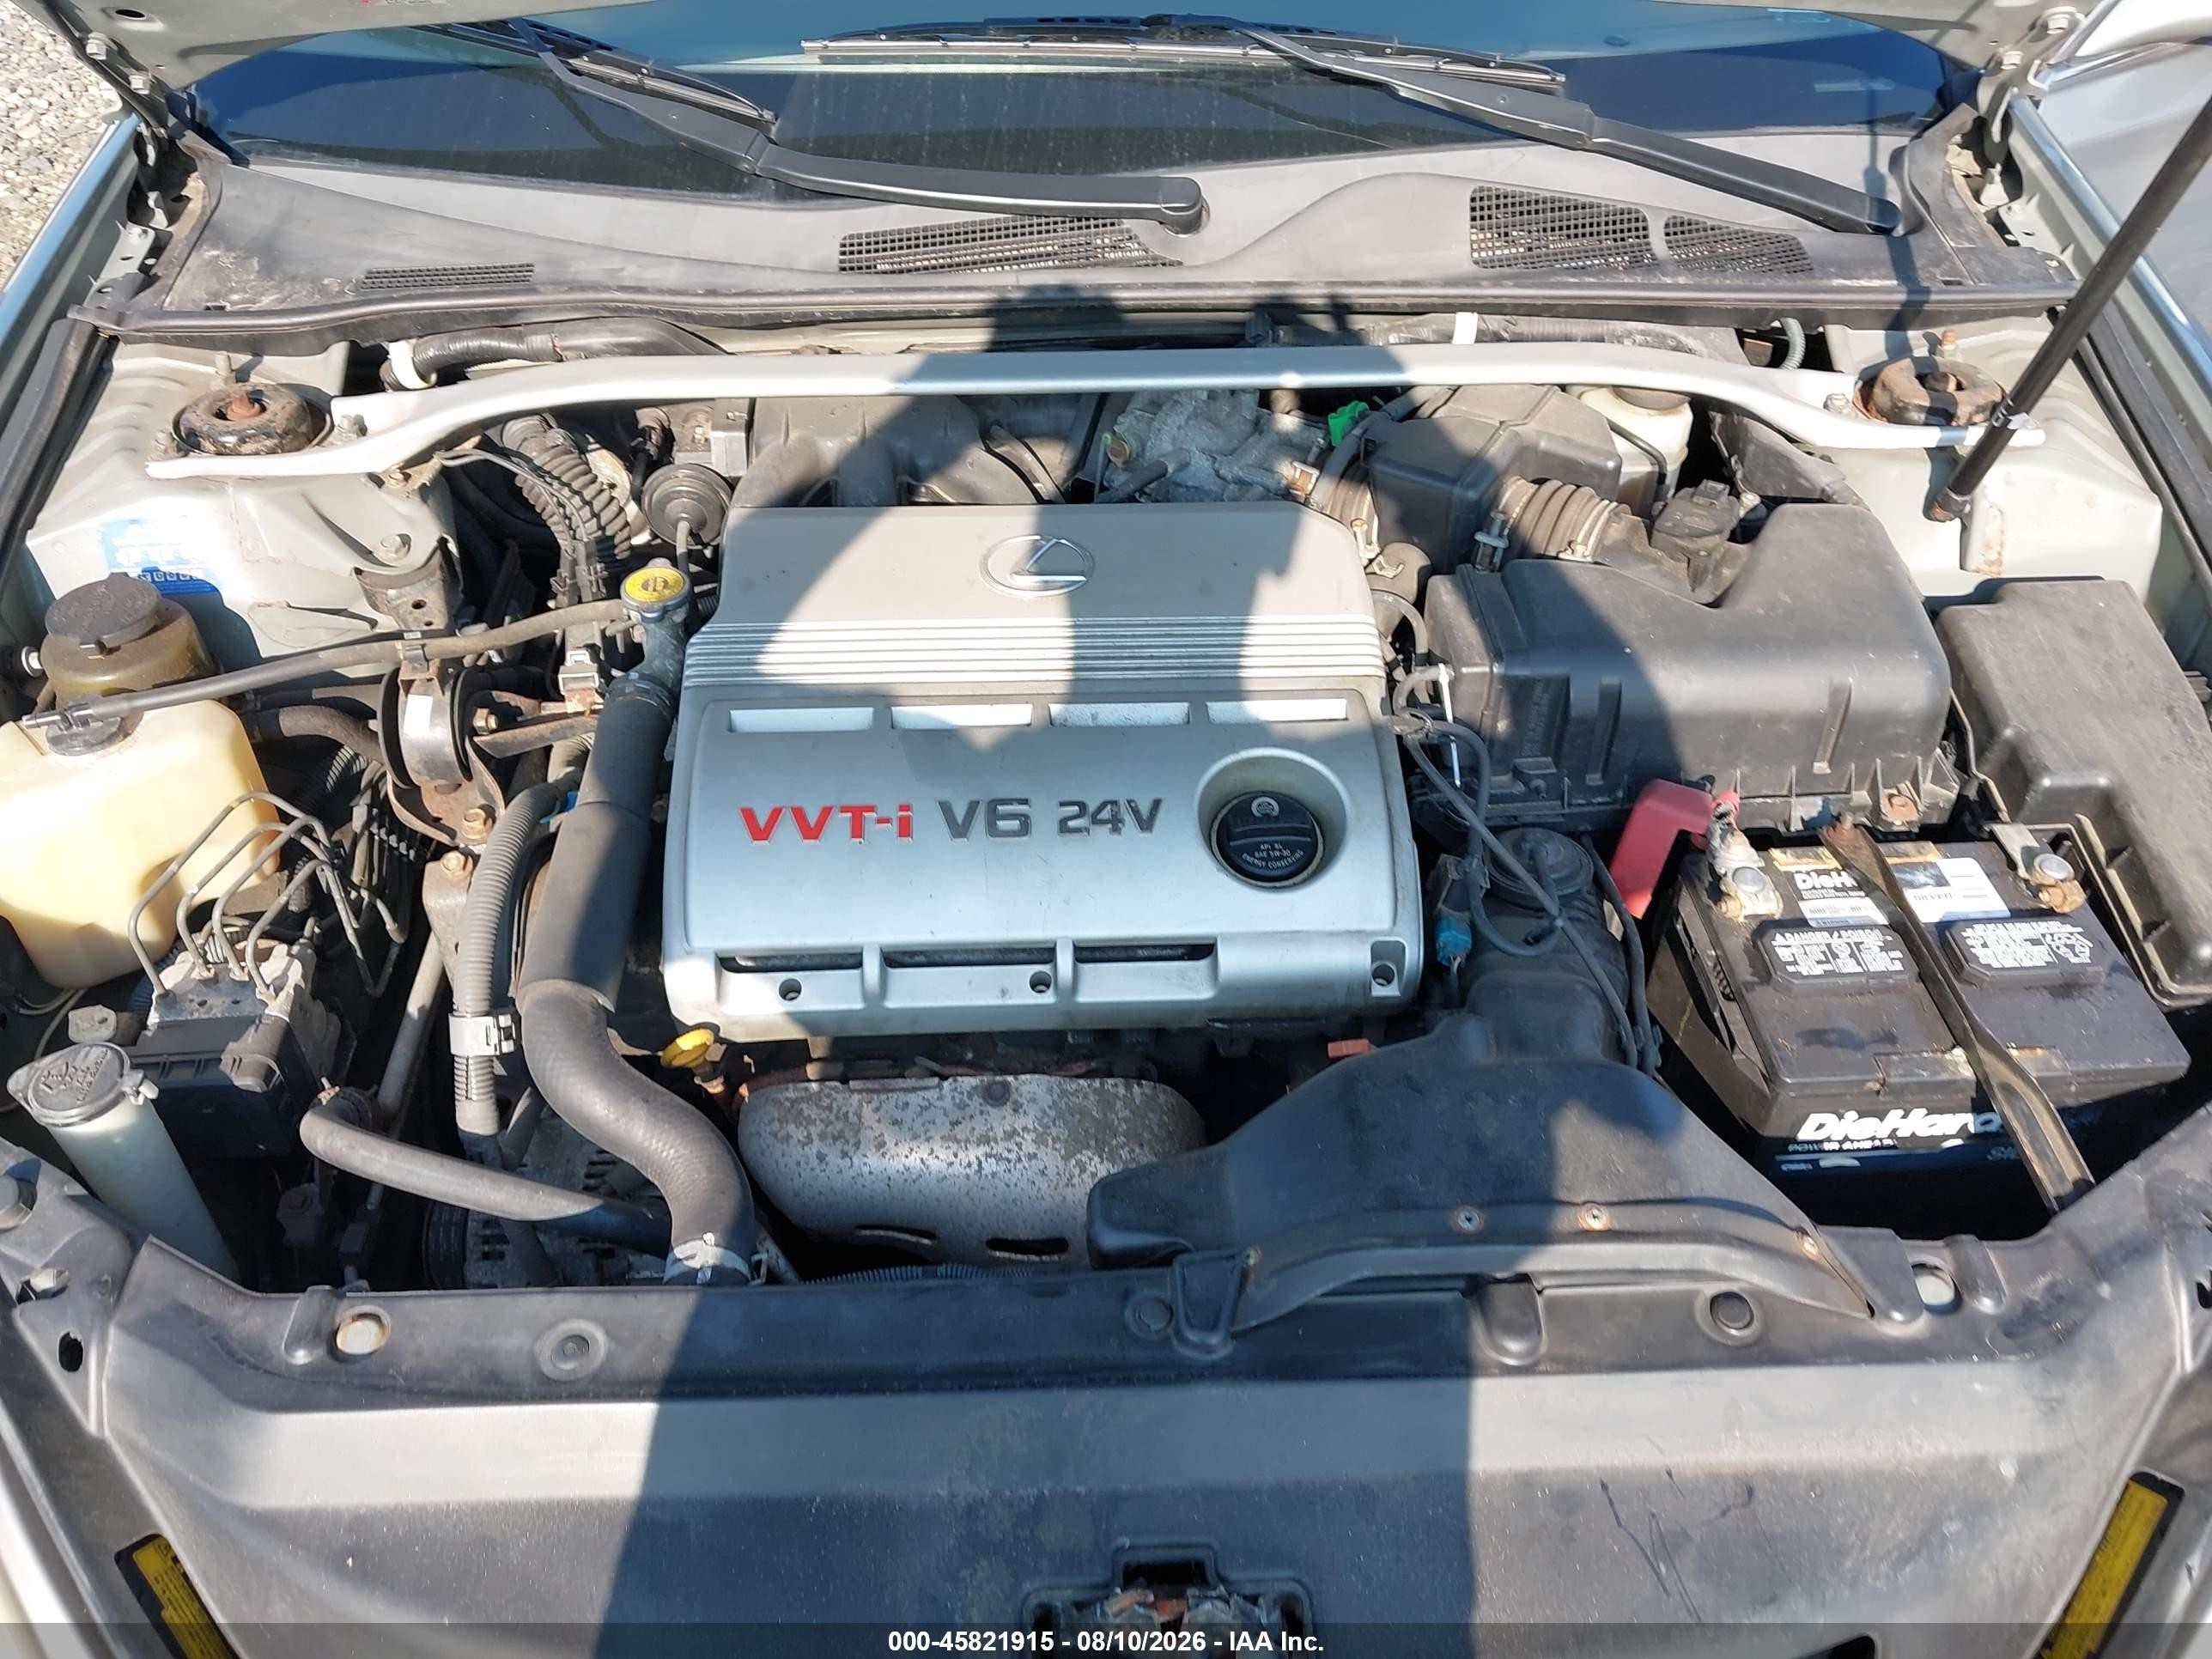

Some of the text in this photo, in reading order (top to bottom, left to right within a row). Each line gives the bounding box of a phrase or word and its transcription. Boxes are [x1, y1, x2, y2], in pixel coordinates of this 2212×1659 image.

[738, 797, 1164, 844] VVT-i V6 24V
[1267, 849, 1304, 869] CONSERVING
[1794, 871, 1859, 890] DieH
[1785, 931, 1832, 942] DANGER
